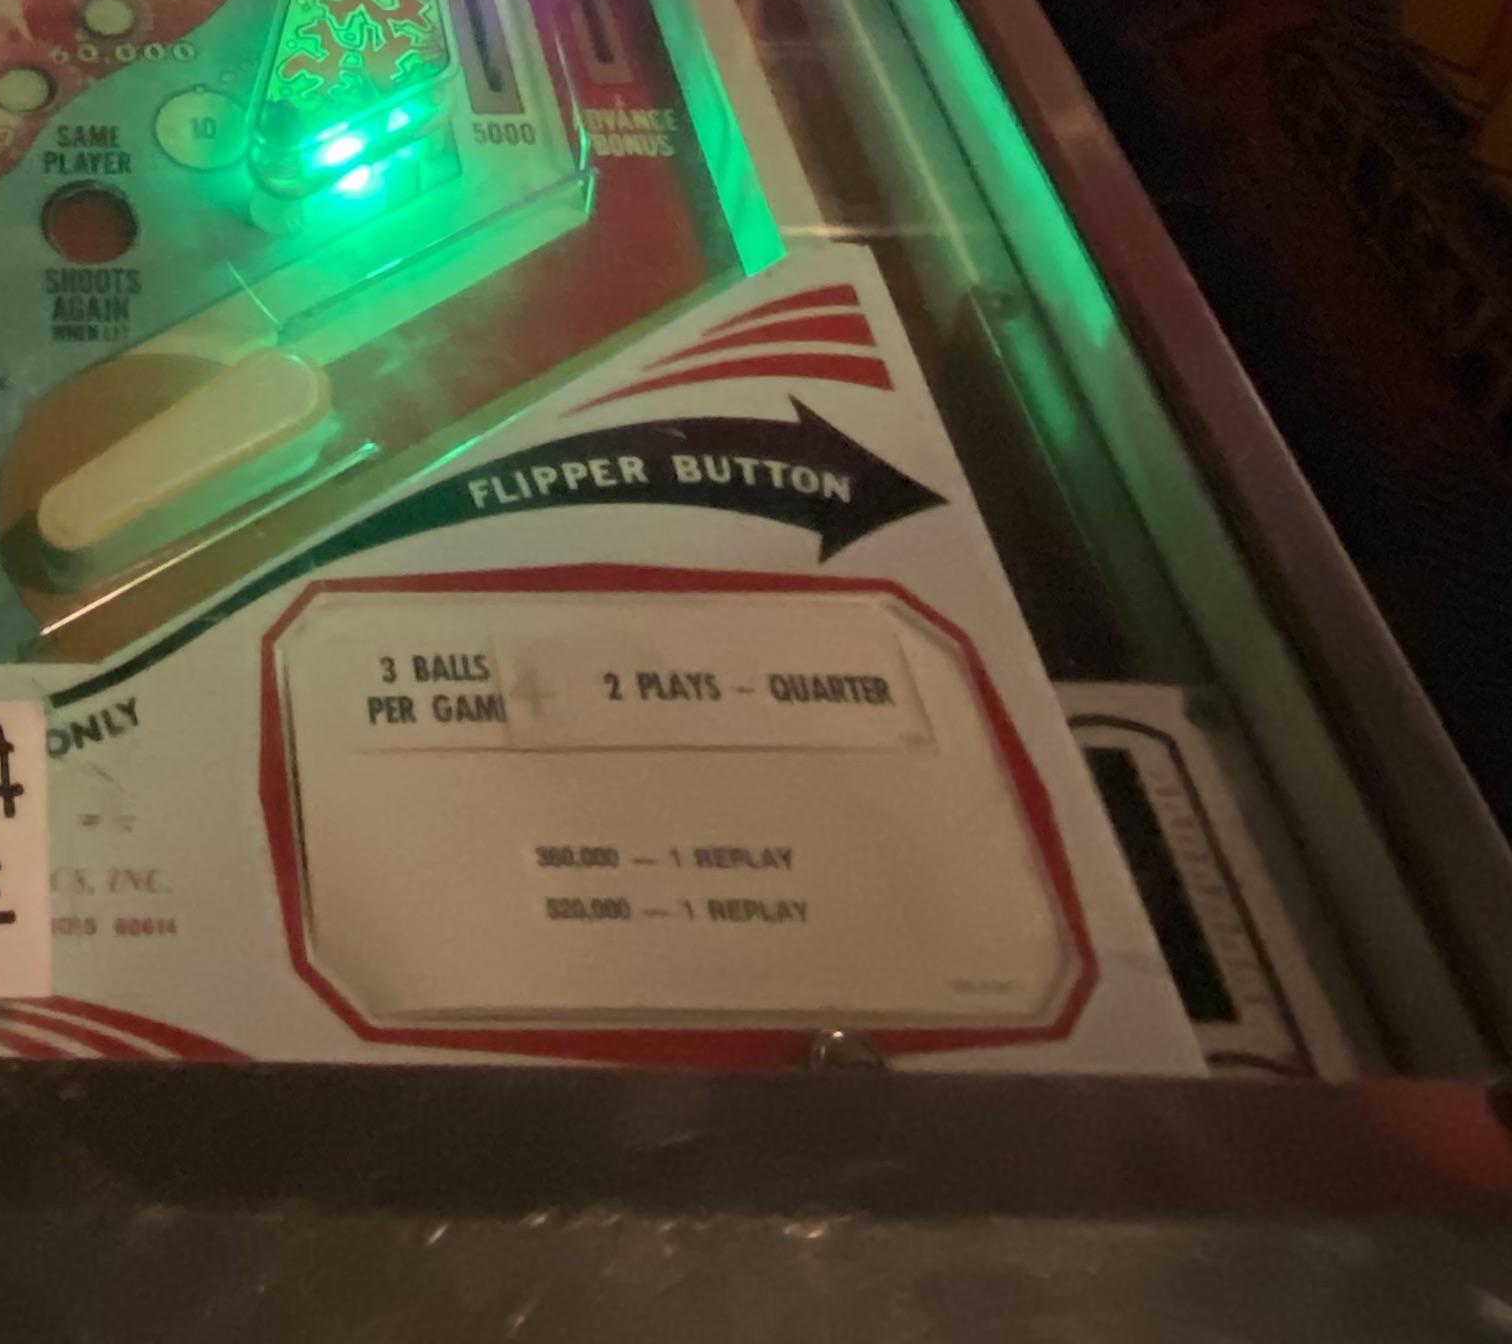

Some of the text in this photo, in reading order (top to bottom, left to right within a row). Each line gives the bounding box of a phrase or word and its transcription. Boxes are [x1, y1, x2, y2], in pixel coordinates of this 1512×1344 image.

[56, 125, 121, 149] SAME
[471, 123, 536, 145] 5000
[590, 132, 675, 157] BONUS
[42, 151, 132, 175] PLAYER
[44, 268, 143, 295] SHOOTS
[52, 295, 131, 322] AGAIN
[469, 454, 854, 509] FLIPPER BUTTON
[380, 653, 492, 683] 3 BALLS
[602, 672, 625, 702] 2
[635, 672, 723, 703] PLAYS
[769, 674, 898, 707] QUARTER
[367, 694, 417, 725] PER
[46, 697, 140, 758] ONLY
[693, 847, 793, 871] REPLAY
[707, 897, 808, 923] REPLAY
